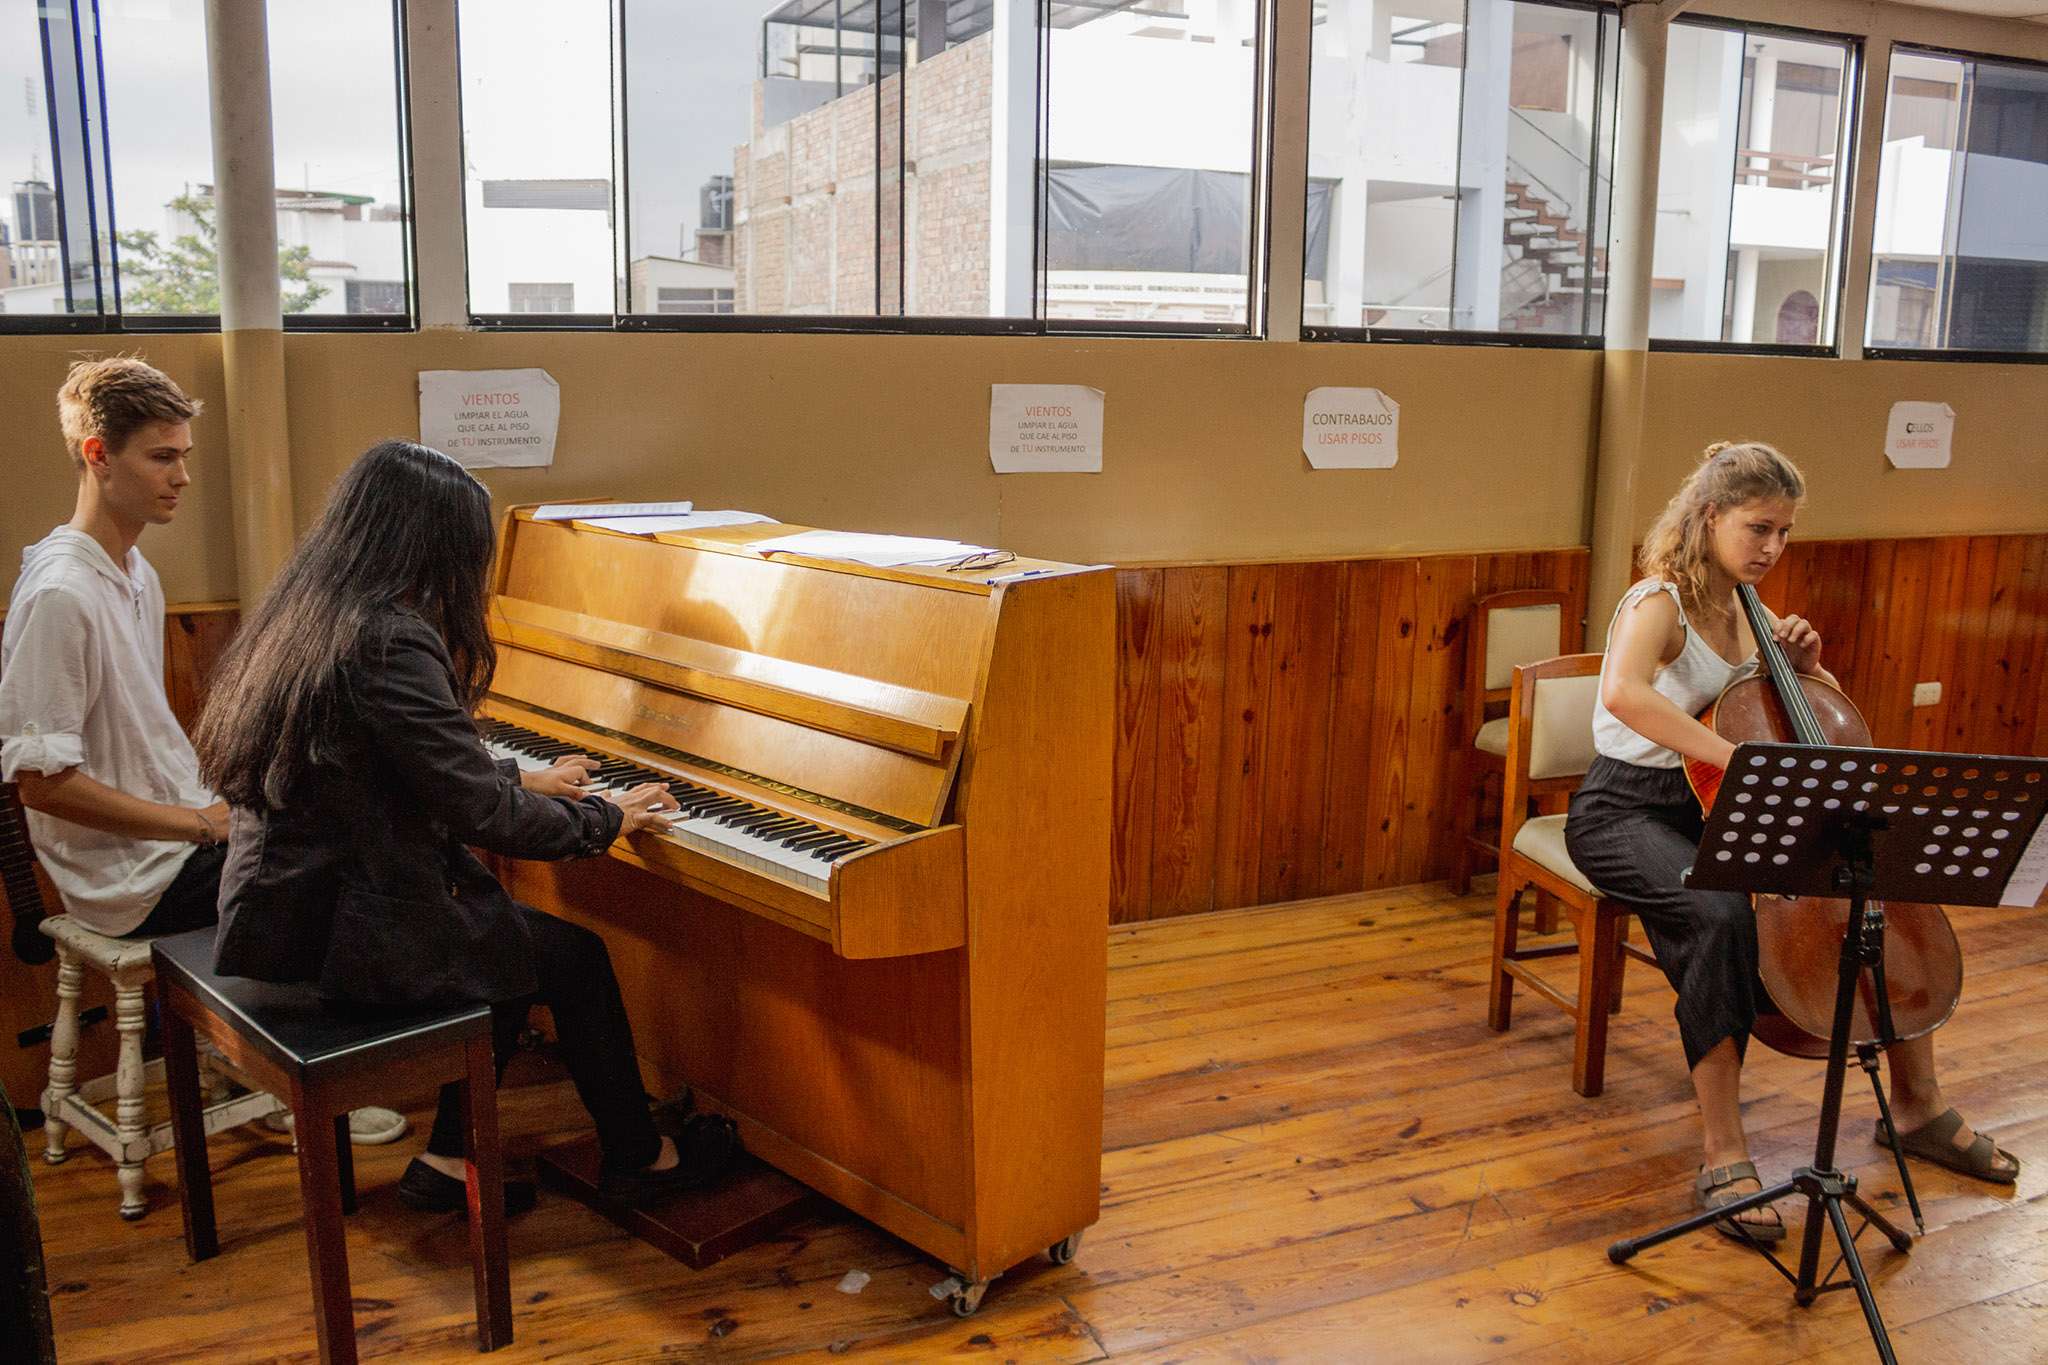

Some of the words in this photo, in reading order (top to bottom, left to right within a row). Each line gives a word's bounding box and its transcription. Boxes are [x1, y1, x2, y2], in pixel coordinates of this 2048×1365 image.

[462, 393, 520, 406] VIENTOS
[454, 412, 490, 420] LIMPIAR
[504, 411, 529, 419] AGUA
[1025, 406, 1072, 417] VIENTOS
[1312, 413, 1393, 426] CONTRABAJOS
[457, 424, 476, 433] QUE
[478, 424, 495, 432] CAE
[497, 423, 508, 431] AL
[510, 422, 530, 431] PISO
[1906, 422, 1934, 434] CELLOS
[462, 437, 475, 447] TU
[477, 437, 541, 446] INSTRUMENTO
[1318, 433, 1348, 445] USAR
[1351, 433, 1383, 445] PISOS
[1022, 444, 1033, 453] TU
[1034, 445, 1086, 453] INSTRUMENTO
